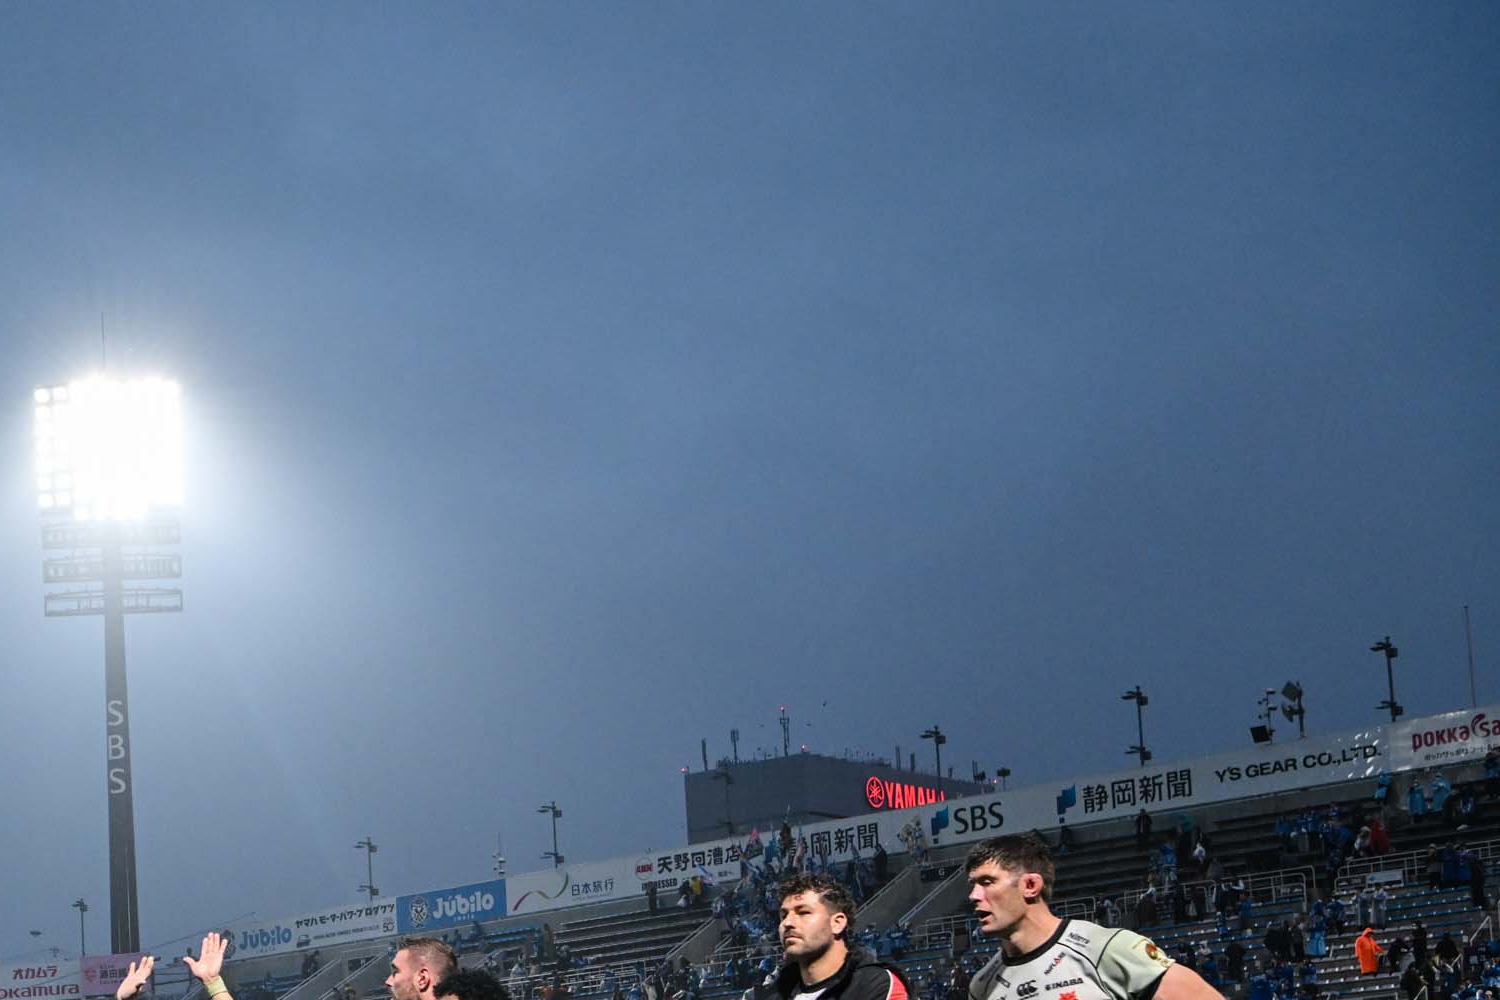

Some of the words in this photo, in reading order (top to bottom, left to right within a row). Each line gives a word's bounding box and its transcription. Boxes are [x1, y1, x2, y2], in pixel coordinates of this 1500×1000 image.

[107, 699, 126, 795] SBS
[1245, 758, 1298, 779] GEAR
[1082, 768, 1193, 814] 静岡新聞
[953, 802, 1004, 835] SBS
[570, 878, 615, 897] 日本旅行
[12, 965, 58, 980] オカムラ
